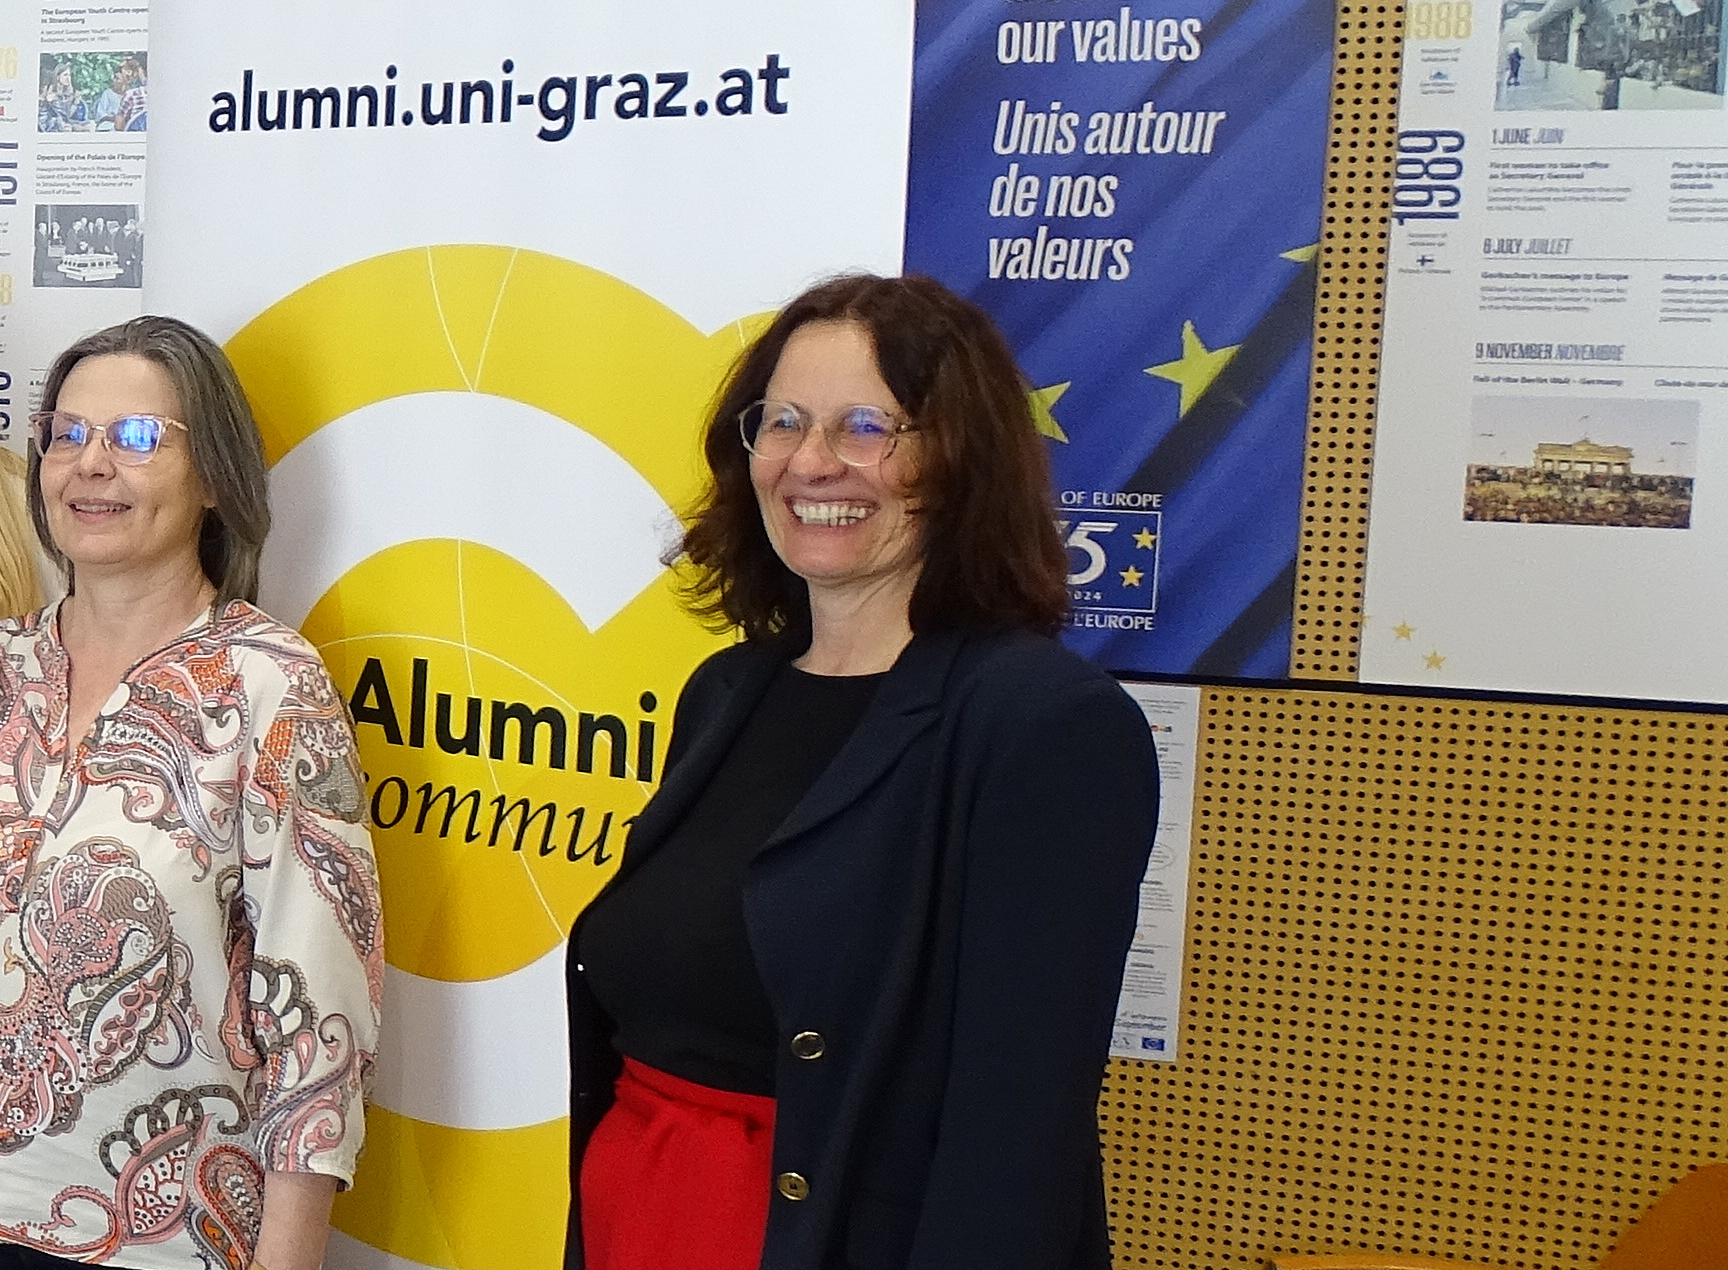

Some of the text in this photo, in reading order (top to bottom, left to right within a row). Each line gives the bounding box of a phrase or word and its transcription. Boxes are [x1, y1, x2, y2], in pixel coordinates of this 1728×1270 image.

[997, 6, 1203, 64] our values
[208, 53, 791, 143] alumni.uni-graz.at
[992, 100, 1227, 155] Unis autour
[1499, 128, 1530, 144] JUNE
[989, 162, 1118, 217] de nos
[1391, 129, 1465, 225] 1989
[987, 225, 1134, 280] valeurs
[1492, 238, 1574, 254] JULY JUILLET
[1486, 342, 1553, 360] NOVEMBER
[1555, 343, 1627, 362] NOVEMBRE
[1061, 491, 1163, 507] OF EUROPE
[1073, 613, 1155, 631] L'EUROPE
[349, 657, 657, 783] Alumni
[363, 771, 640, 866] ommu
